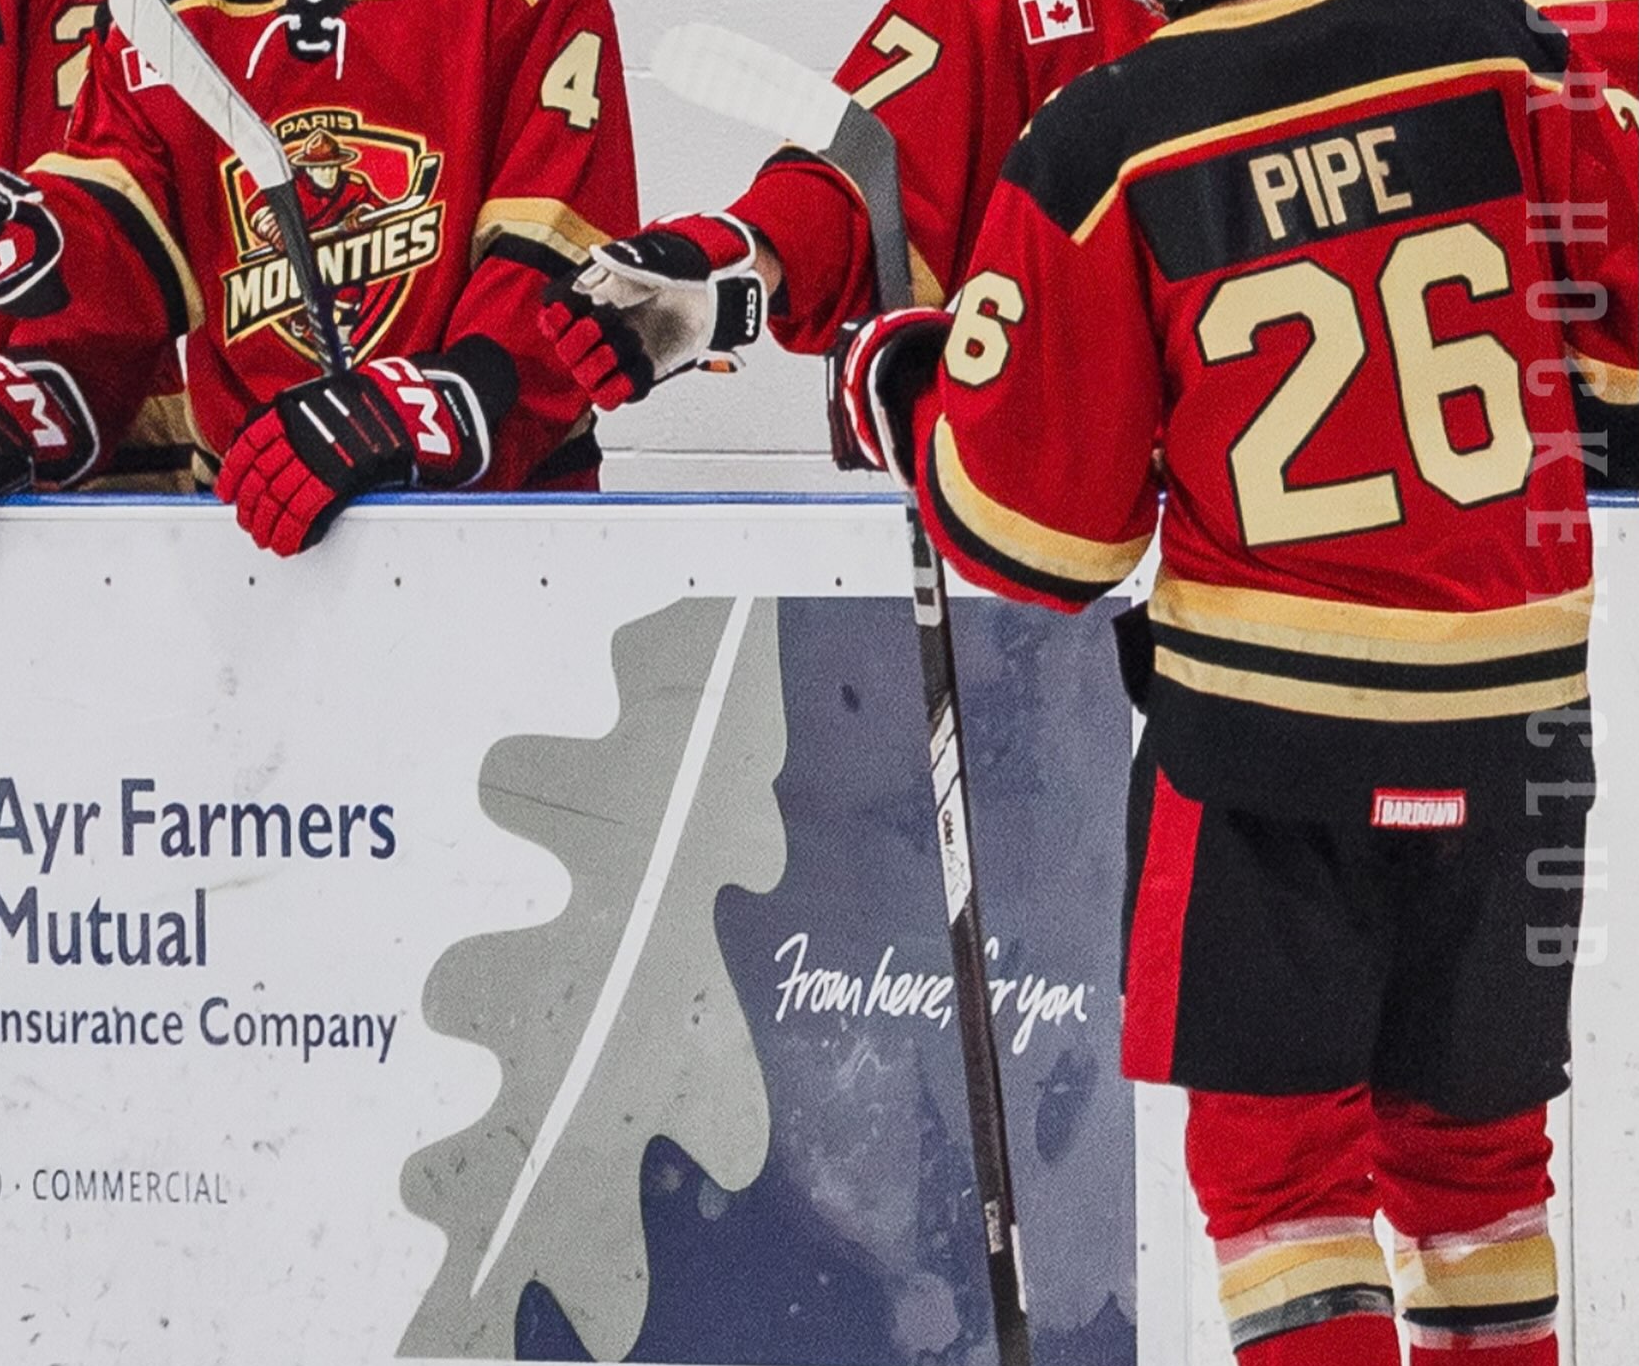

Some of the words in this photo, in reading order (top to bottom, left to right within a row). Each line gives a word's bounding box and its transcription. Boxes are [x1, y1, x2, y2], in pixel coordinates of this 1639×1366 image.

[541, 31, 603, 129] 4
[849, 14, 943, 110] 7
[280, 113, 355, 139] PARIS
[1247, 126, 1412, 241] PIPE
[745, 286, 758, 338] CCM
[943, 271, 1026, 387] 6
[1195, 219, 1535, 549] 26
[120, 777, 397, 859] Farmers
[1381, 799, 1460, 827] BARDOWN
[774, 933, 864, 1023] From
[863, 945, 955, 1030] here,
[199, 997, 398, 1063] Company
[32, 1168, 228, 1206] COMMERCIAL
